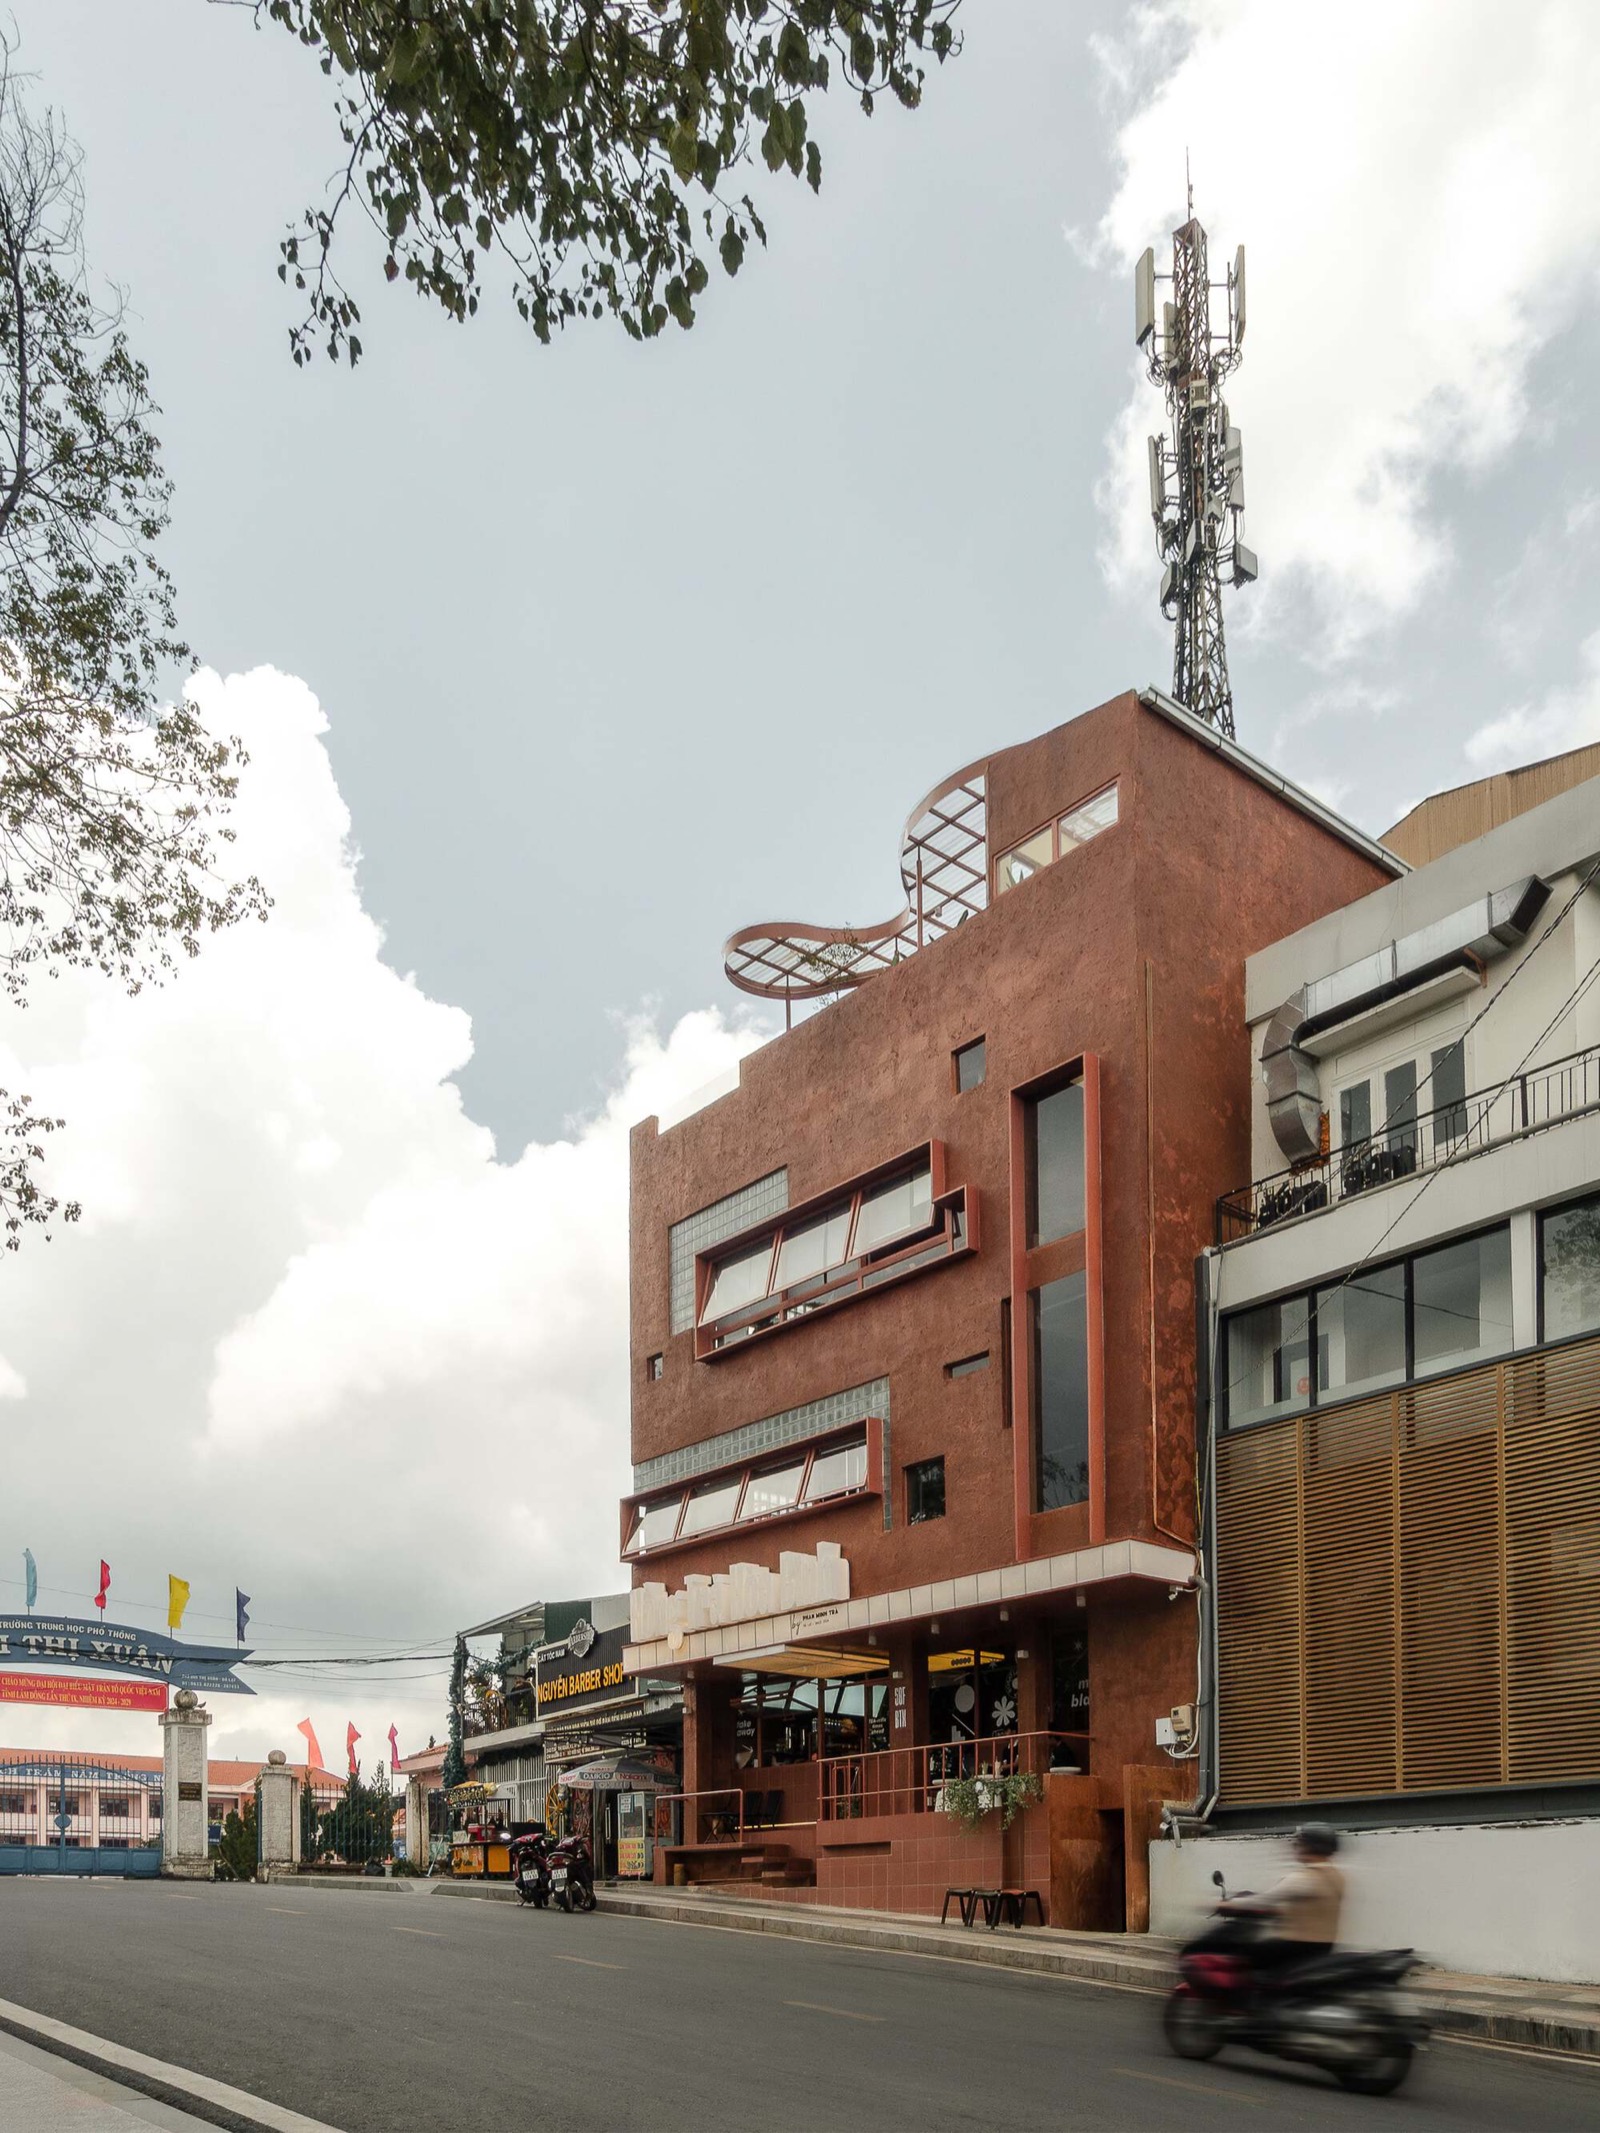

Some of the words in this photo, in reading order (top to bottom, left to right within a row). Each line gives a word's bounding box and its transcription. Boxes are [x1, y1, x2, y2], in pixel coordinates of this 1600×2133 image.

[36, 1622, 65, 1631] TRUNG
[66, 1624, 85, 1635] HỌC
[87, 1625, 105, 1636] PHỔ
[108, 1629, 137, 1641] THÔNG
[21, 1635, 80, 1662] THỊ
[89, 1641, 174, 1674] XUÂN
[547, 1650, 555, 1661] TÓC
[555, 1649, 565, 1659] NAM
[569, 1668, 601, 1696] BARBER
[119, 1684, 135, 1695] QUỐC
[736, 1720, 752, 1728] take
[736, 1727, 755, 1737] away
[71, 1769, 100, 1779] NĂM
[583, 1772, 610, 1780] DAIKIO
